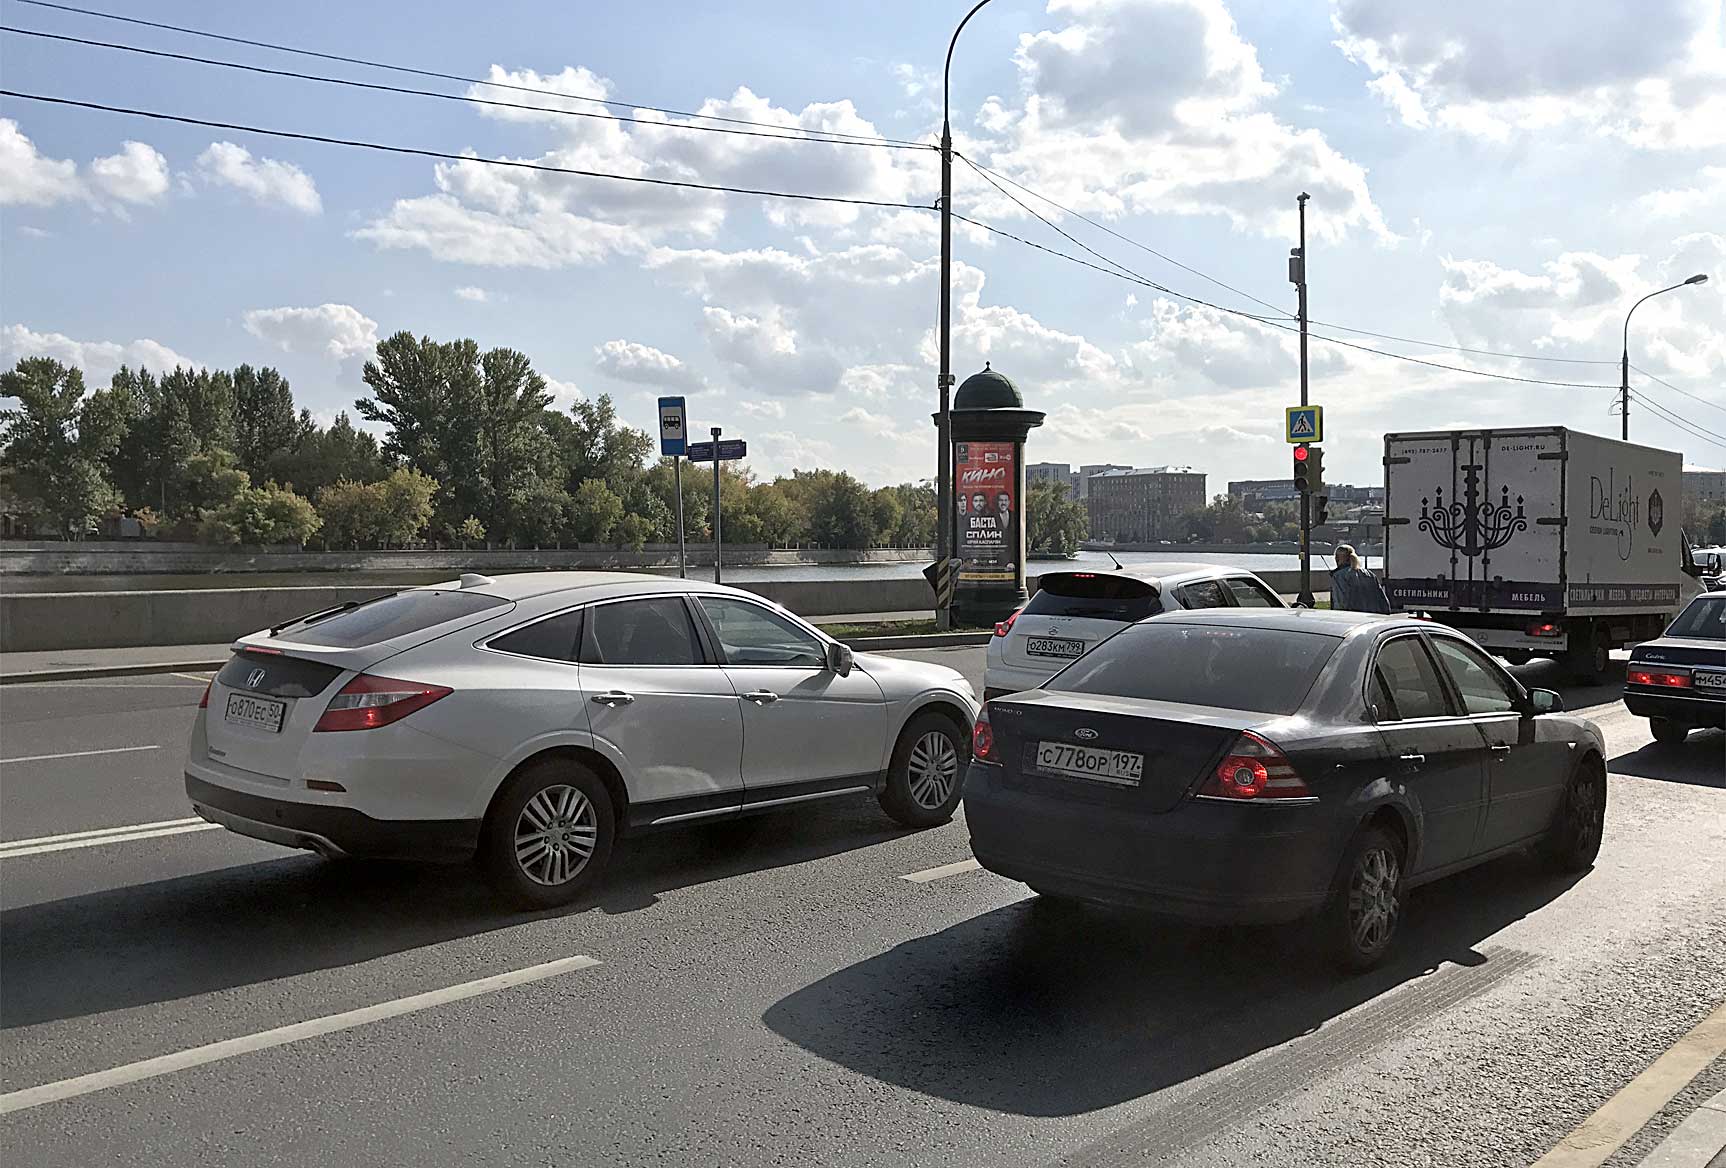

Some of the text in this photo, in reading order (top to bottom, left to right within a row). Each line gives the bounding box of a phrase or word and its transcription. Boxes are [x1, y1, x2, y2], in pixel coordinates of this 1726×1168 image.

[1501, 444, 1546, 452] DE-LIGHT.RU
[962, 467, 1006, 483] КИНО
[1590, 467, 1640, 561] DeLight
[970, 517, 997, 529] БАСТА
[966, 529, 1002, 539] СПЛИН
[1393, 588, 1449, 599] СВЕТИЛЬНИКИ
[1511, 593, 1546, 602] МЕБЕЛЬ
[1066, 641, 1080, 651] 799
[268, 703, 280, 719] 50
[1042, 745, 1138, 771] С778ОР 197
